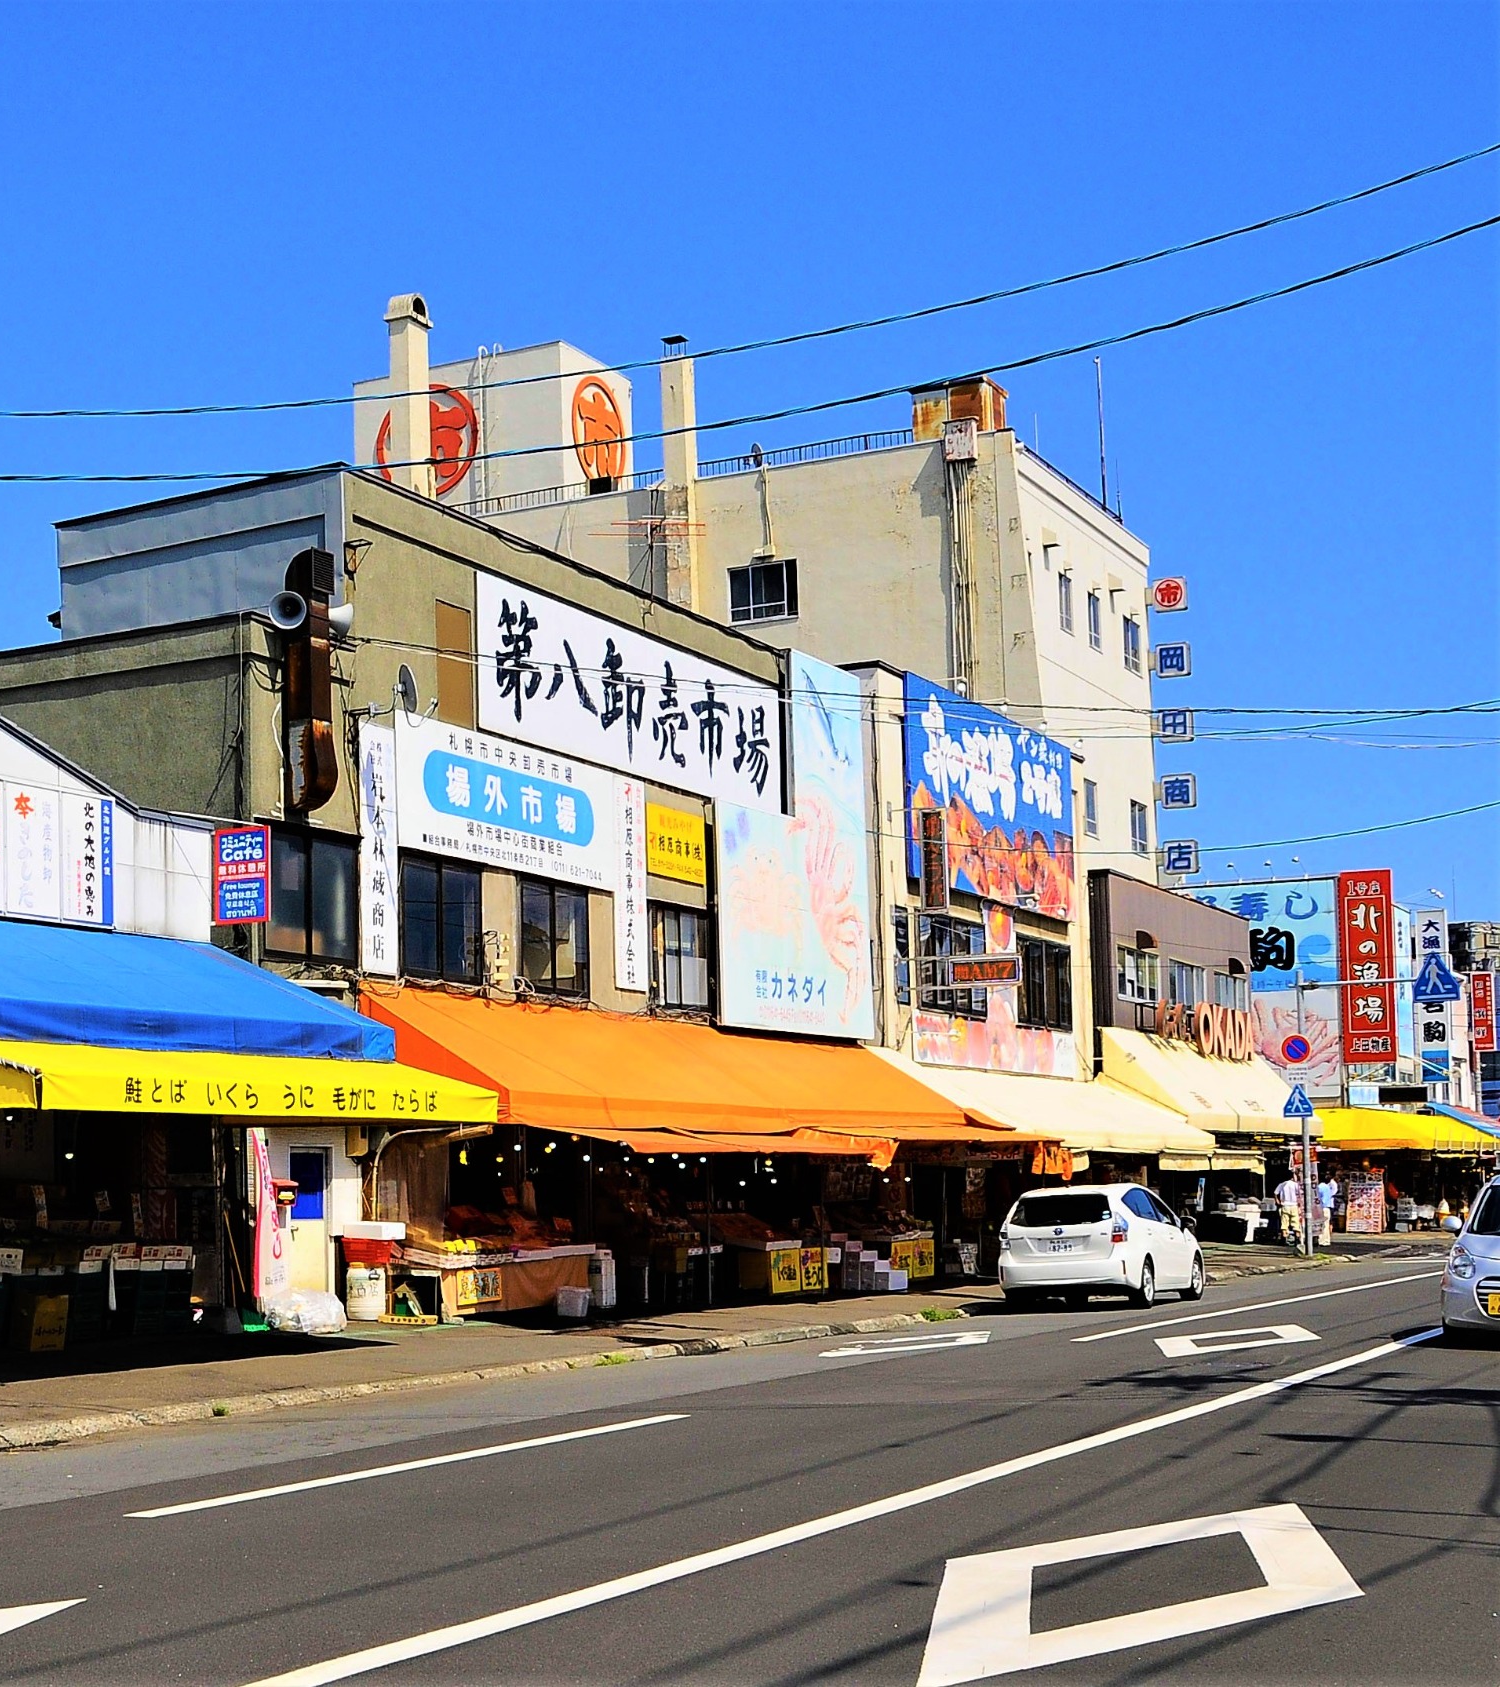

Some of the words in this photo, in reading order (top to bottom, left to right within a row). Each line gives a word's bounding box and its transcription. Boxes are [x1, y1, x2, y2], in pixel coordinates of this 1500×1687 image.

[496, 599, 770, 797] 第八卸売市場
[449, 731, 573, 783] 札幌市中央卸売市場
[1158, 645, 1193, 871] 岡田商店
[446, 763, 576, 834] 場外市場
[84, 801, 96, 917] 北の大地の恵み
[238, 882, 260, 890] lounge
[370, 772, 386, 961] 岩本林蔵商店
[1347, 880, 1381, 896] 1号店
[771, 971, 827, 1006] カネダイ
[1350, 902, 1385, 1024] 北の漁場
[1201, 1001, 1254, 1061] OKADA
[125, 1076, 188, 1104] 鮭とば
[206, 1081, 259, 1109] いくら
[284, 1084, 315, 1110] うに
[332, 1087, 377, 1111] 毛がに
[393, 1088, 438, 1113] たらば
